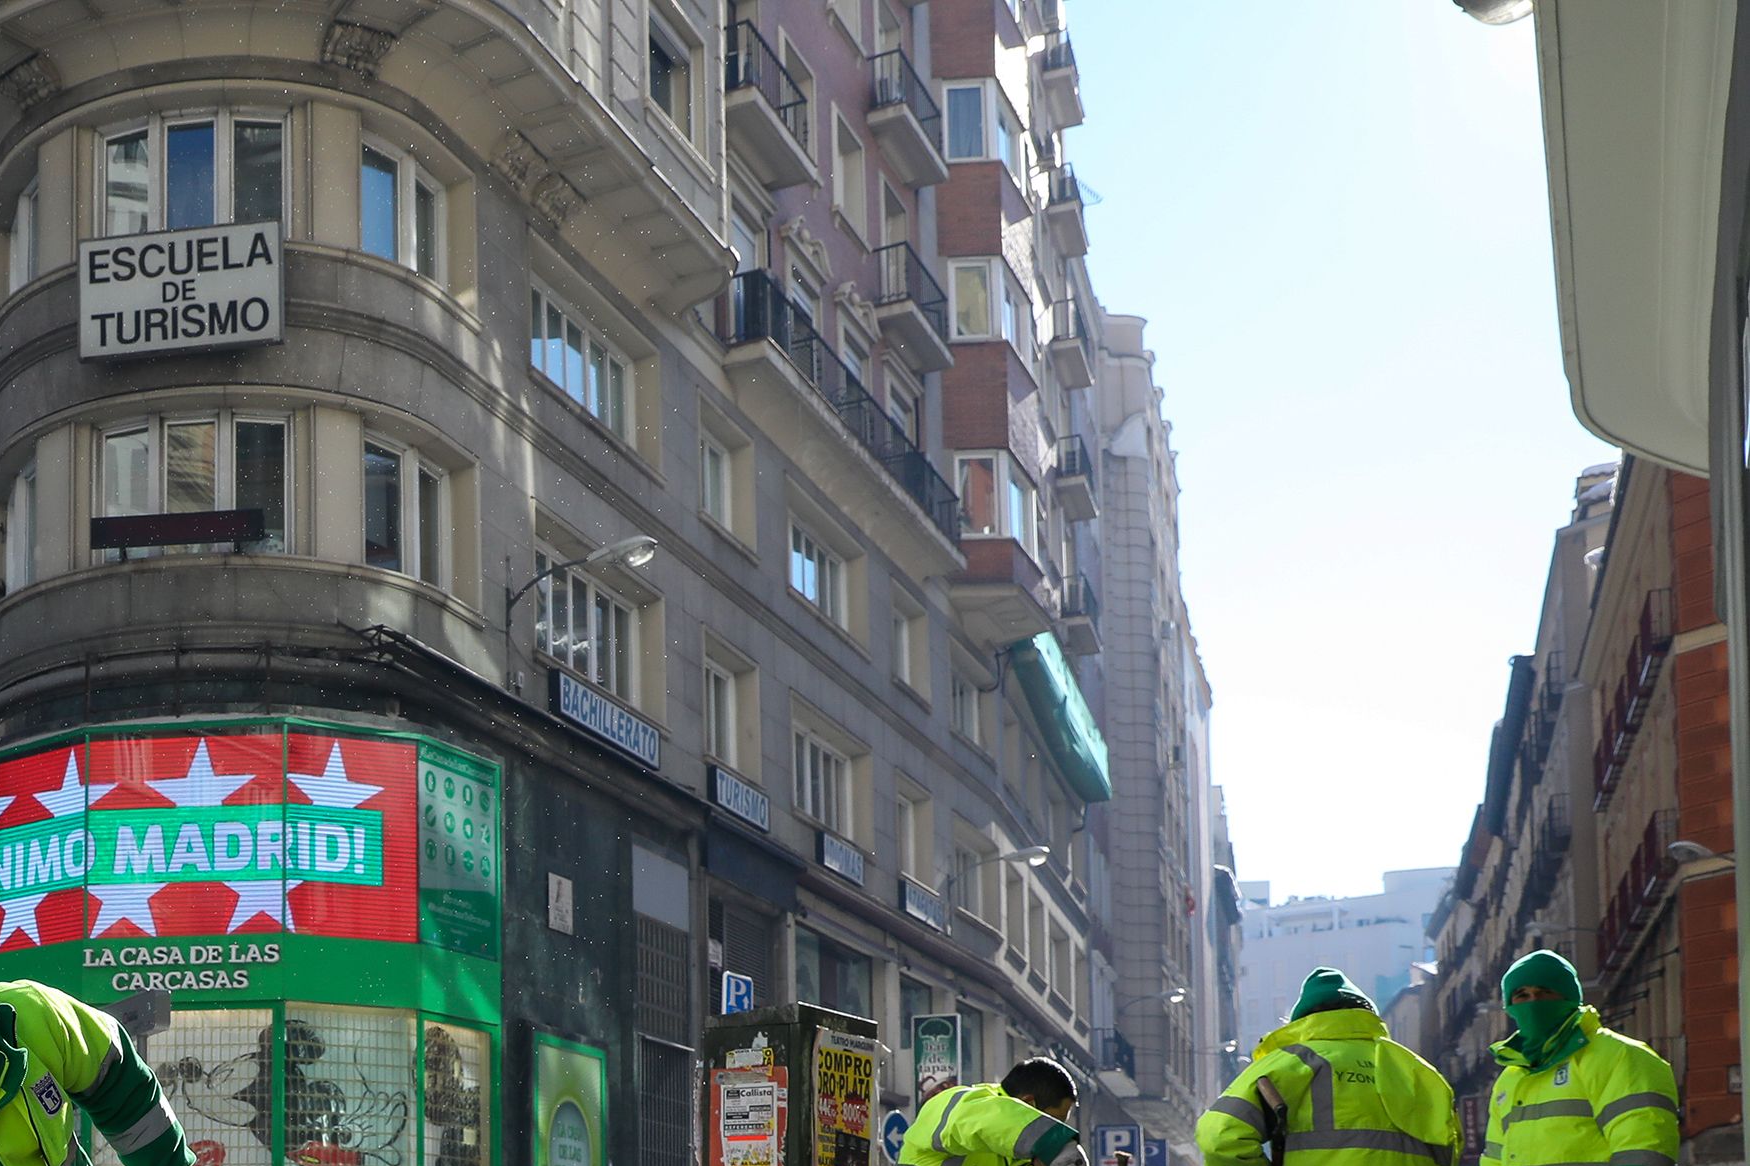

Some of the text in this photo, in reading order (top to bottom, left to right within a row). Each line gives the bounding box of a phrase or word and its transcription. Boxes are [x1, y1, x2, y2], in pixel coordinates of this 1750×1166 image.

[89, 232, 273, 284] ESCUELA
[162, 279, 196, 303] DE
[91, 297, 270, 347] TURISMO
[563, 677, 657, 761] BACHILLERATO
[718, 772, 767, 825] TURISMO
[113, 821, 366, 875] MADRID!
[83, 943, 280, 967] LA CASA DE LAS
[112, 970, 250, 992] CARCASAS
[729, 977, 747, 1007] P
[924, 1041, 946, 1051] bar
[919, 1064, 954, 1075] tapas
[929, 1054, 941, 1063] de
[1335, 1071, 1375, 1084] Y ZON
[1105, 1131, 1130, 1156] P
